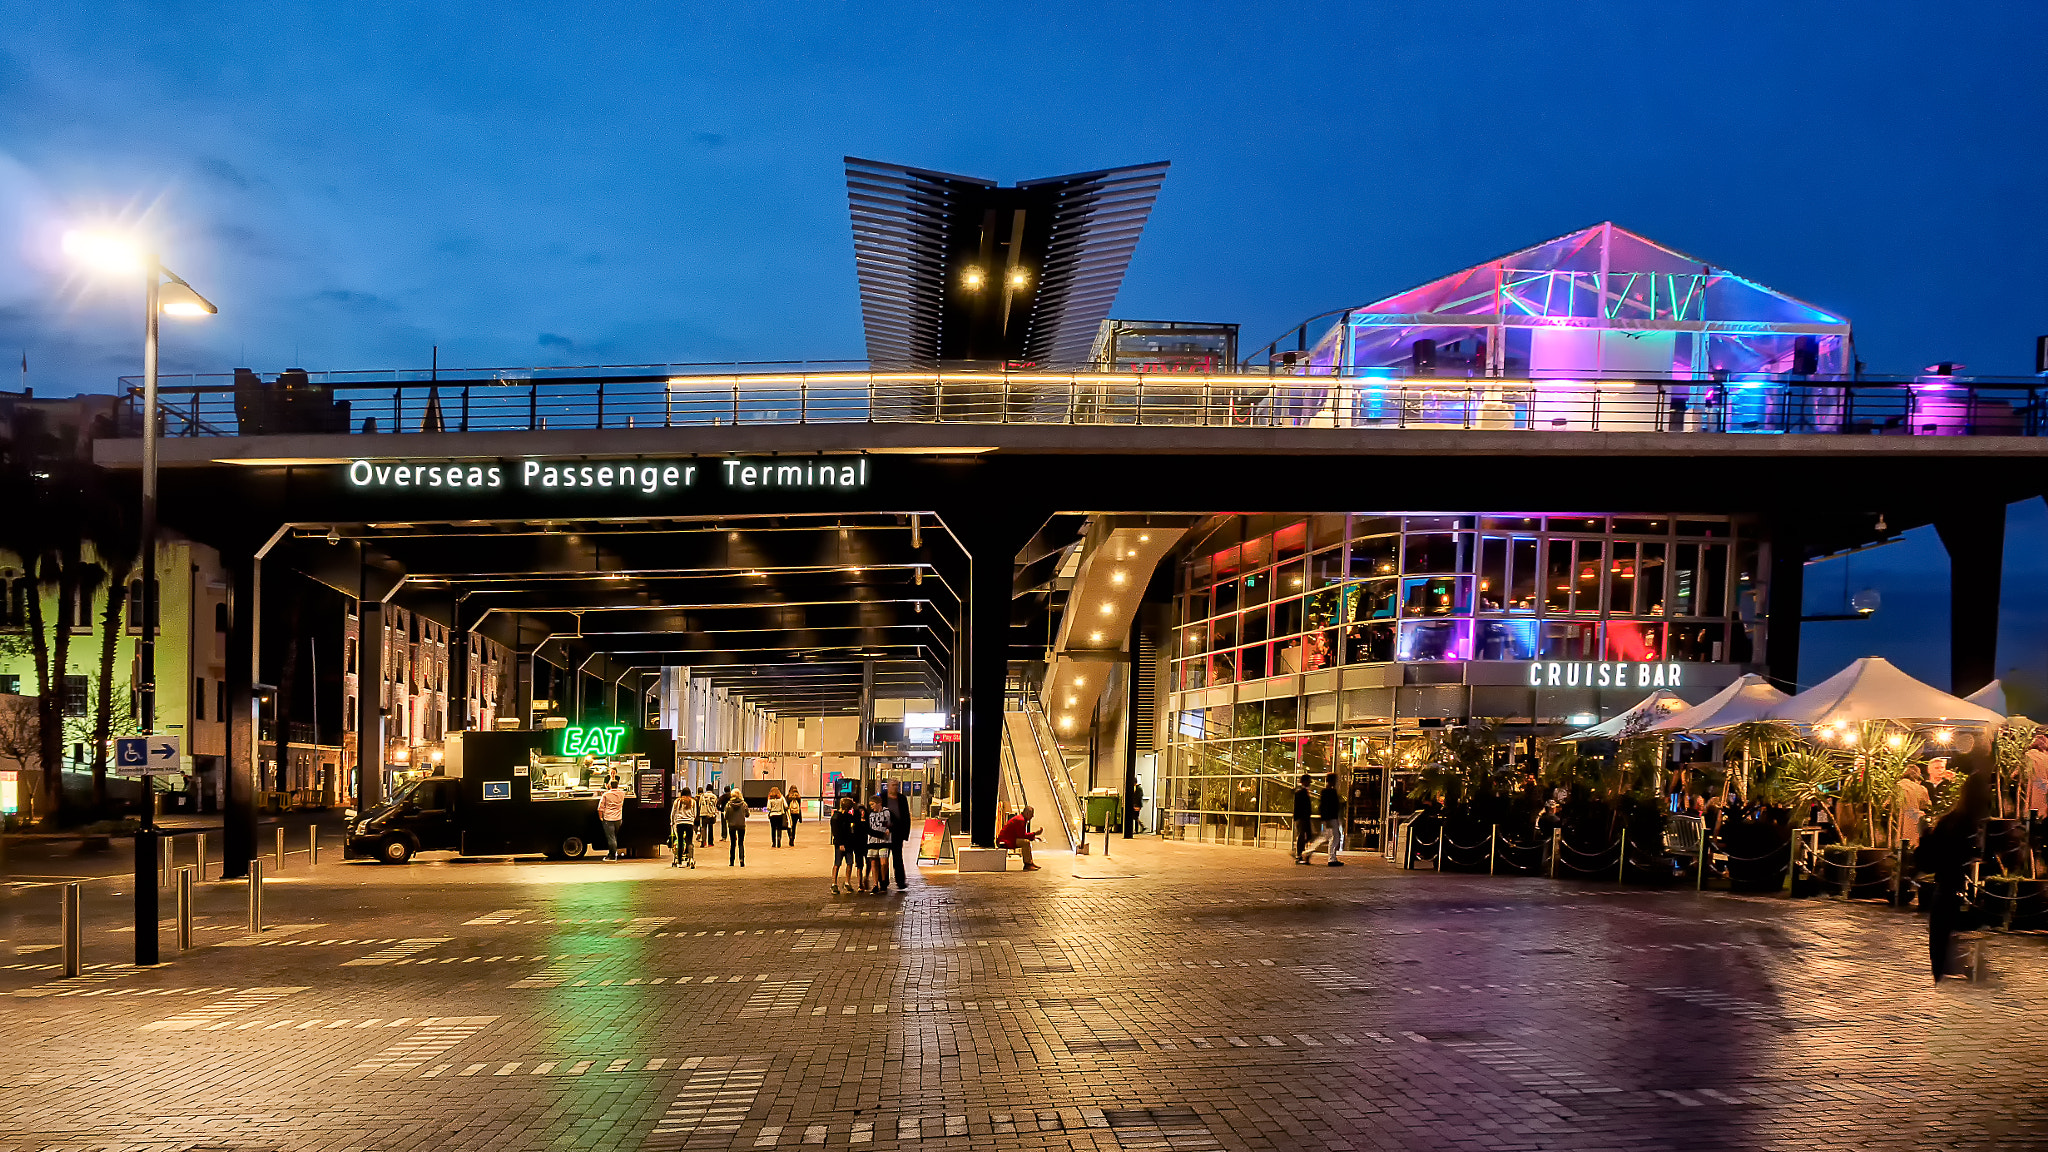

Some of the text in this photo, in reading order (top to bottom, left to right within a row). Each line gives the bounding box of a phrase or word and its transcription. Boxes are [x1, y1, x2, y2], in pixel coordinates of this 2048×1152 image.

[349, 459, 867, 493] Overseas Passenger Terminal
[1529, 662, 1682, 687] CRUISE BAR
[563, 726, 625, 755] EAT
[942, 734, 952, 742] Pay
